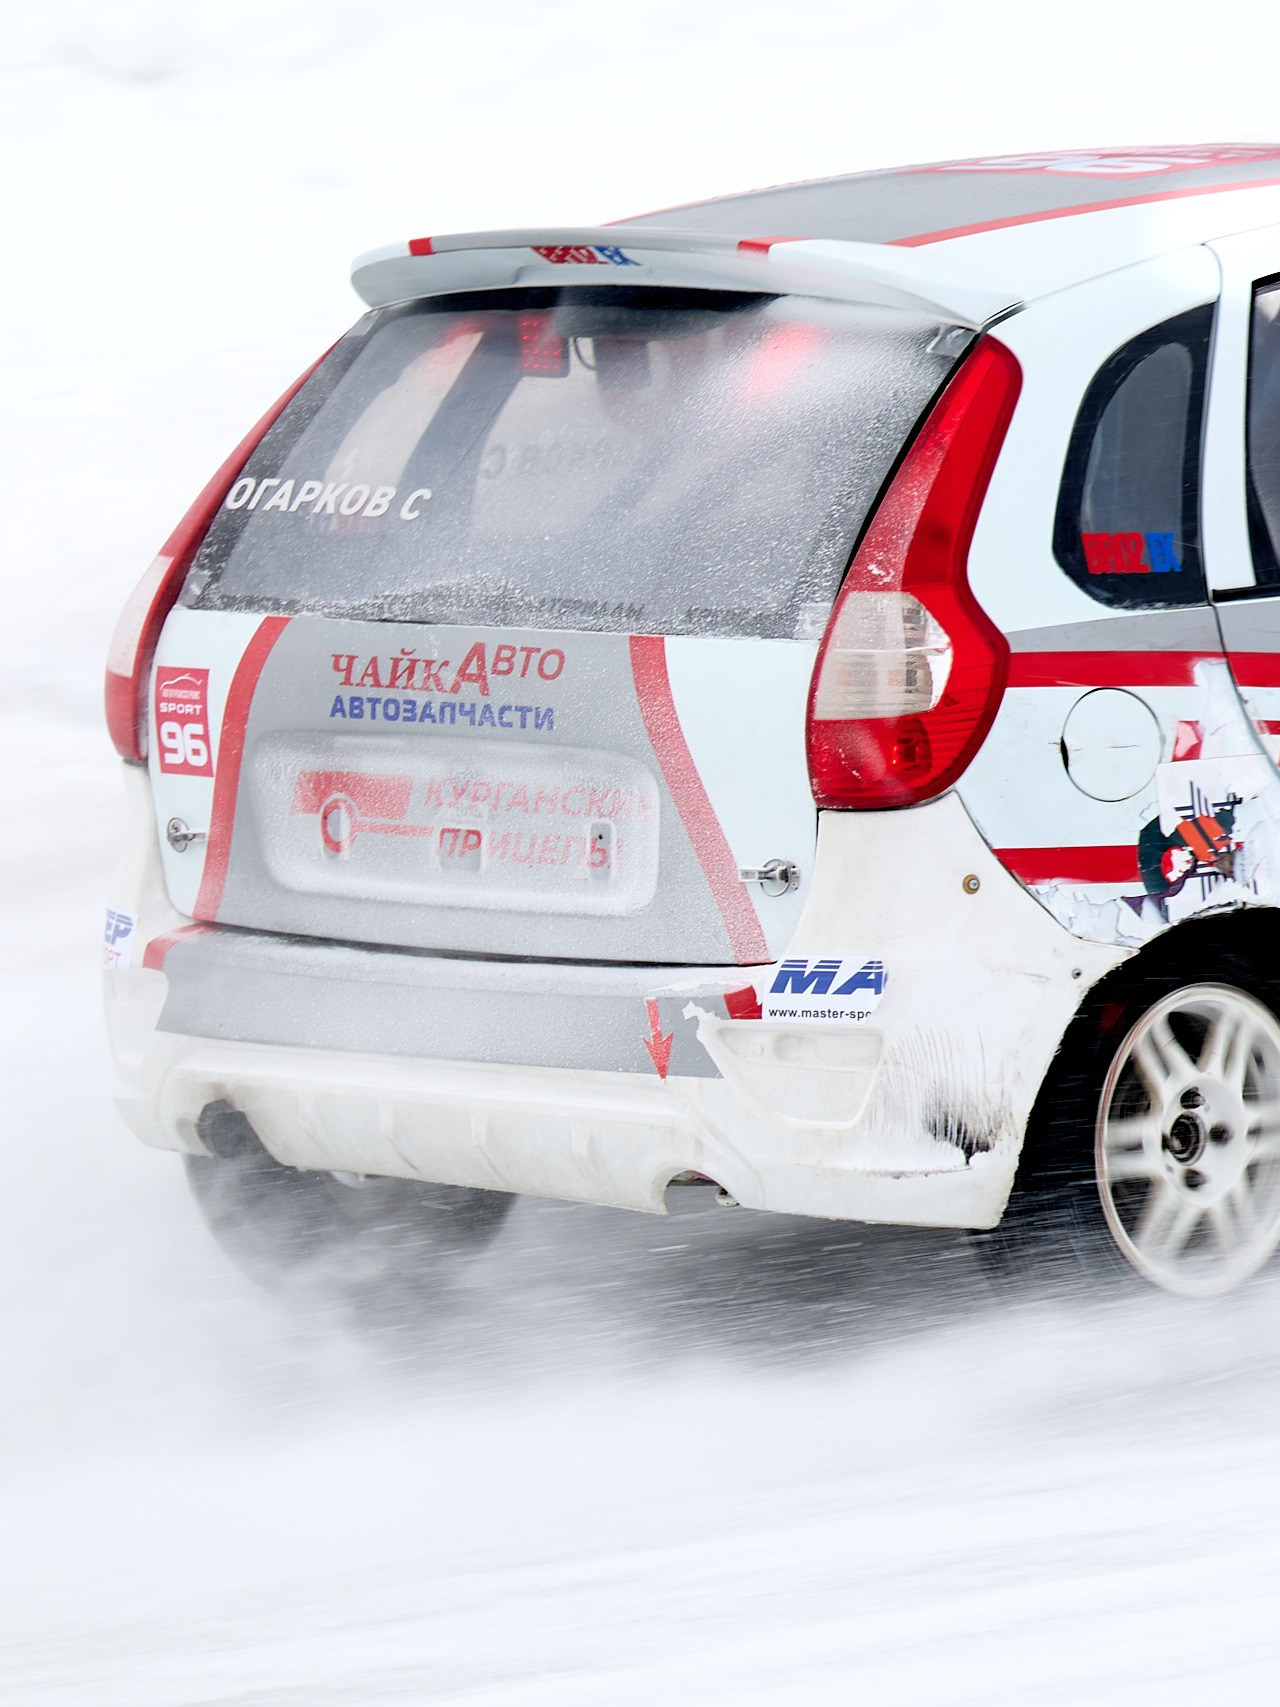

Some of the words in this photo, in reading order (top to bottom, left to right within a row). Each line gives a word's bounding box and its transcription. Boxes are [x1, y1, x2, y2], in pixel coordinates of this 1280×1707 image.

[225, 477, 397, 517] ОГАРКОВ
[400, 488, 432, 521] С
[160, 702, 202, 715] SPORT
[329, 695, 554, 731] АВТОЗАПЧАСТИ
[161, 721, 208, 767] 96
